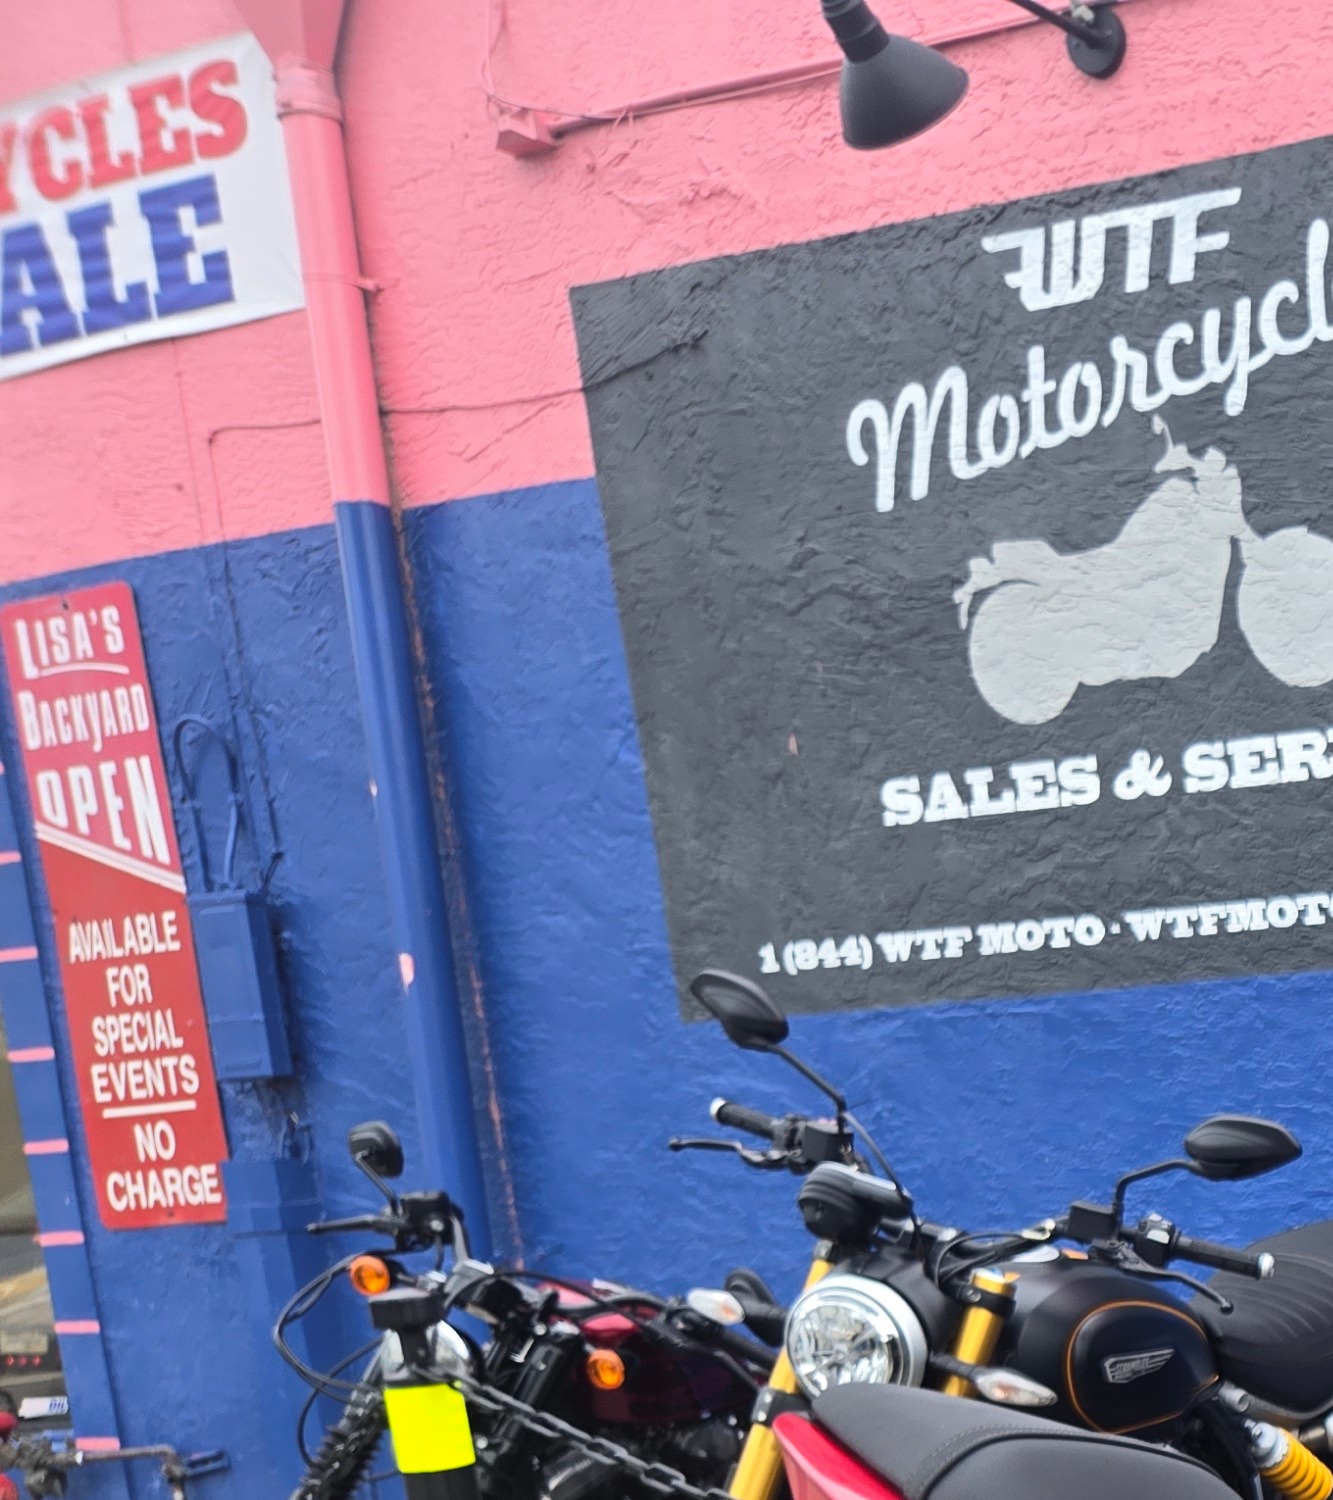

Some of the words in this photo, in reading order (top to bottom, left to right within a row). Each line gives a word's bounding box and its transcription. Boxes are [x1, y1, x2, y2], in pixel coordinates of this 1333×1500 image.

[981, 187, 1241, 311] WTF
[36, 755, 171, 865] OPEN
[881, 754, 1100, 827] SALES
[1112, 748, 1171, 801] &
[68, 910, 181, 964] AVAILABLE
[758, 943, 780, 974] 1
[783, 933, 874, 976] (844)
[876, 926, 972, 963] WTF
[976, 913, 1106, 956] MOTO
[105, 963, 153, 1008] FOR
[92, 1008, 184, 1057] SPECIAL
[90, 1053, 200, 1104] EVENTS
[133, 1119, 176, 1163] NO
[106, 1163, 222, 1212] CHARGE
